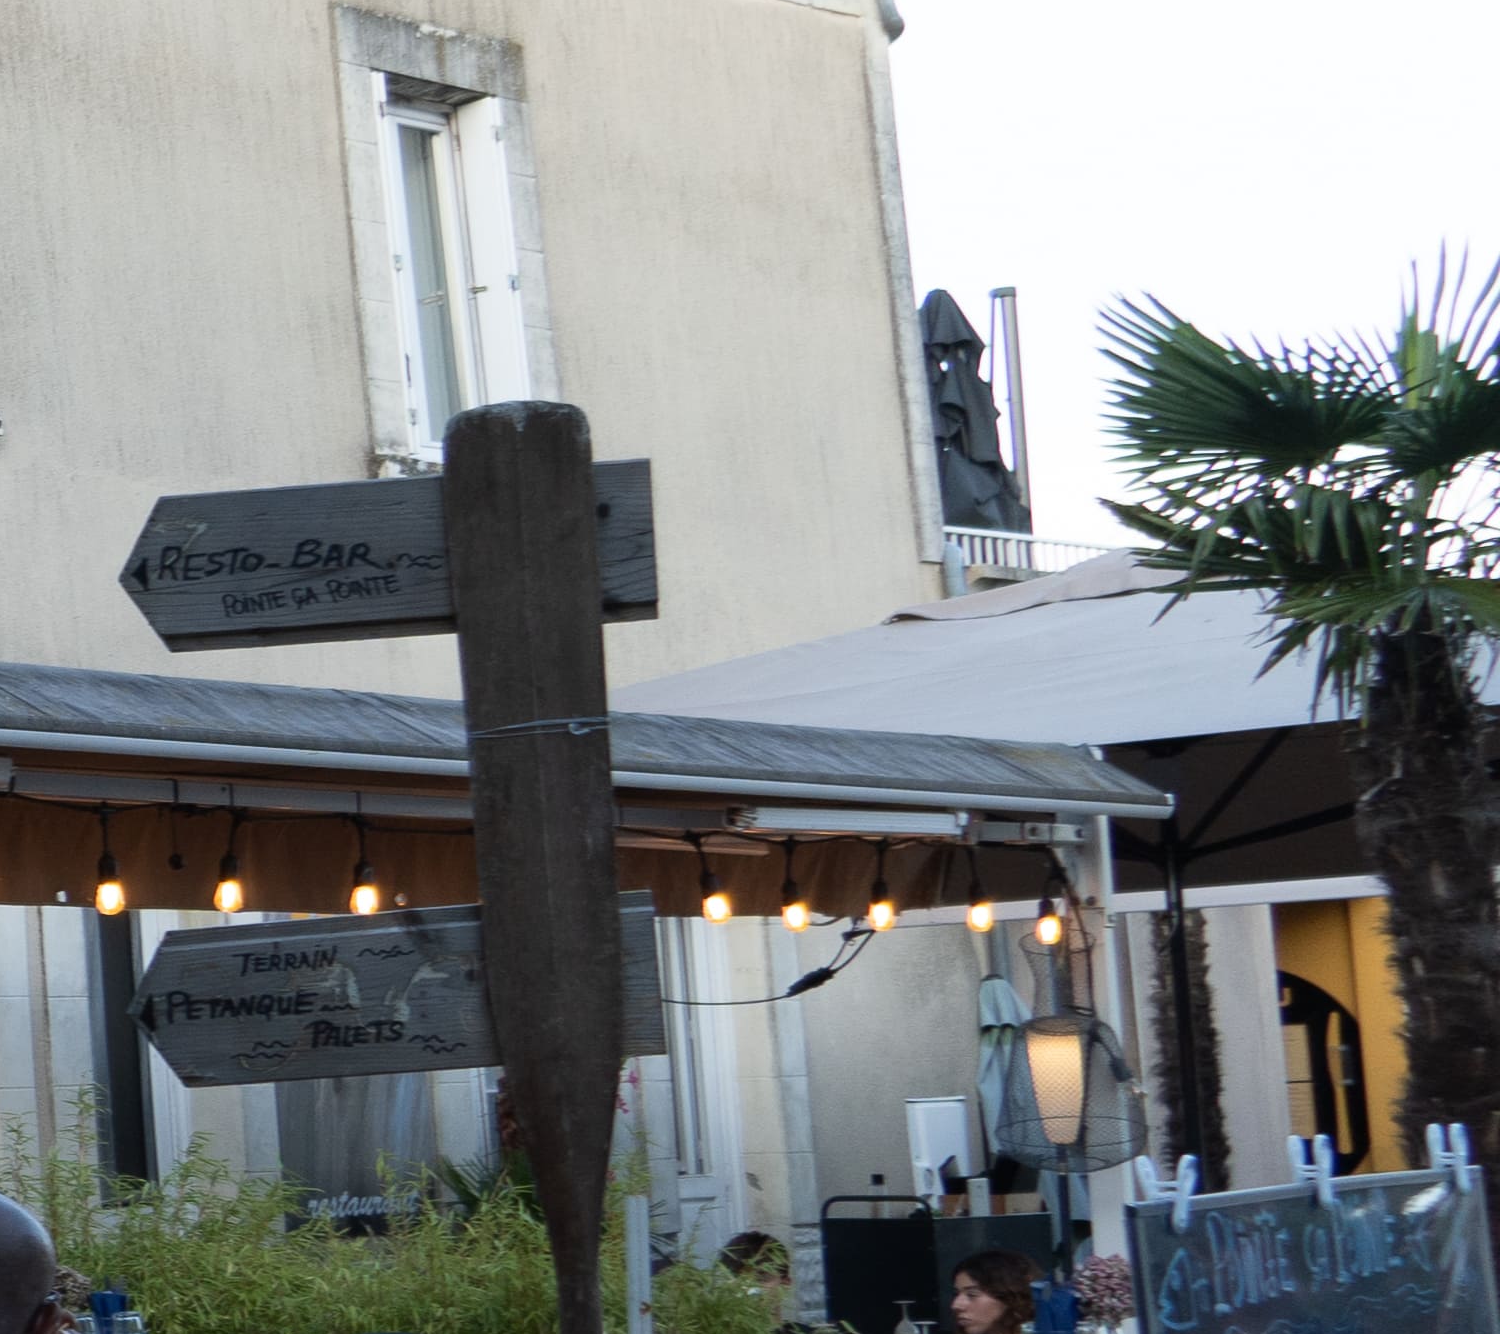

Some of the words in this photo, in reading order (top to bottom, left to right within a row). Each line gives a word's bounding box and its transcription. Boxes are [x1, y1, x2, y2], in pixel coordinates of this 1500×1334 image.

[222, 591, 287, 617] POINTE
[328, 574, 399, 604] POINTE
[232, 944, 339, 977] TERRAIN
[309, 1020, 406, 1049] PALETS
